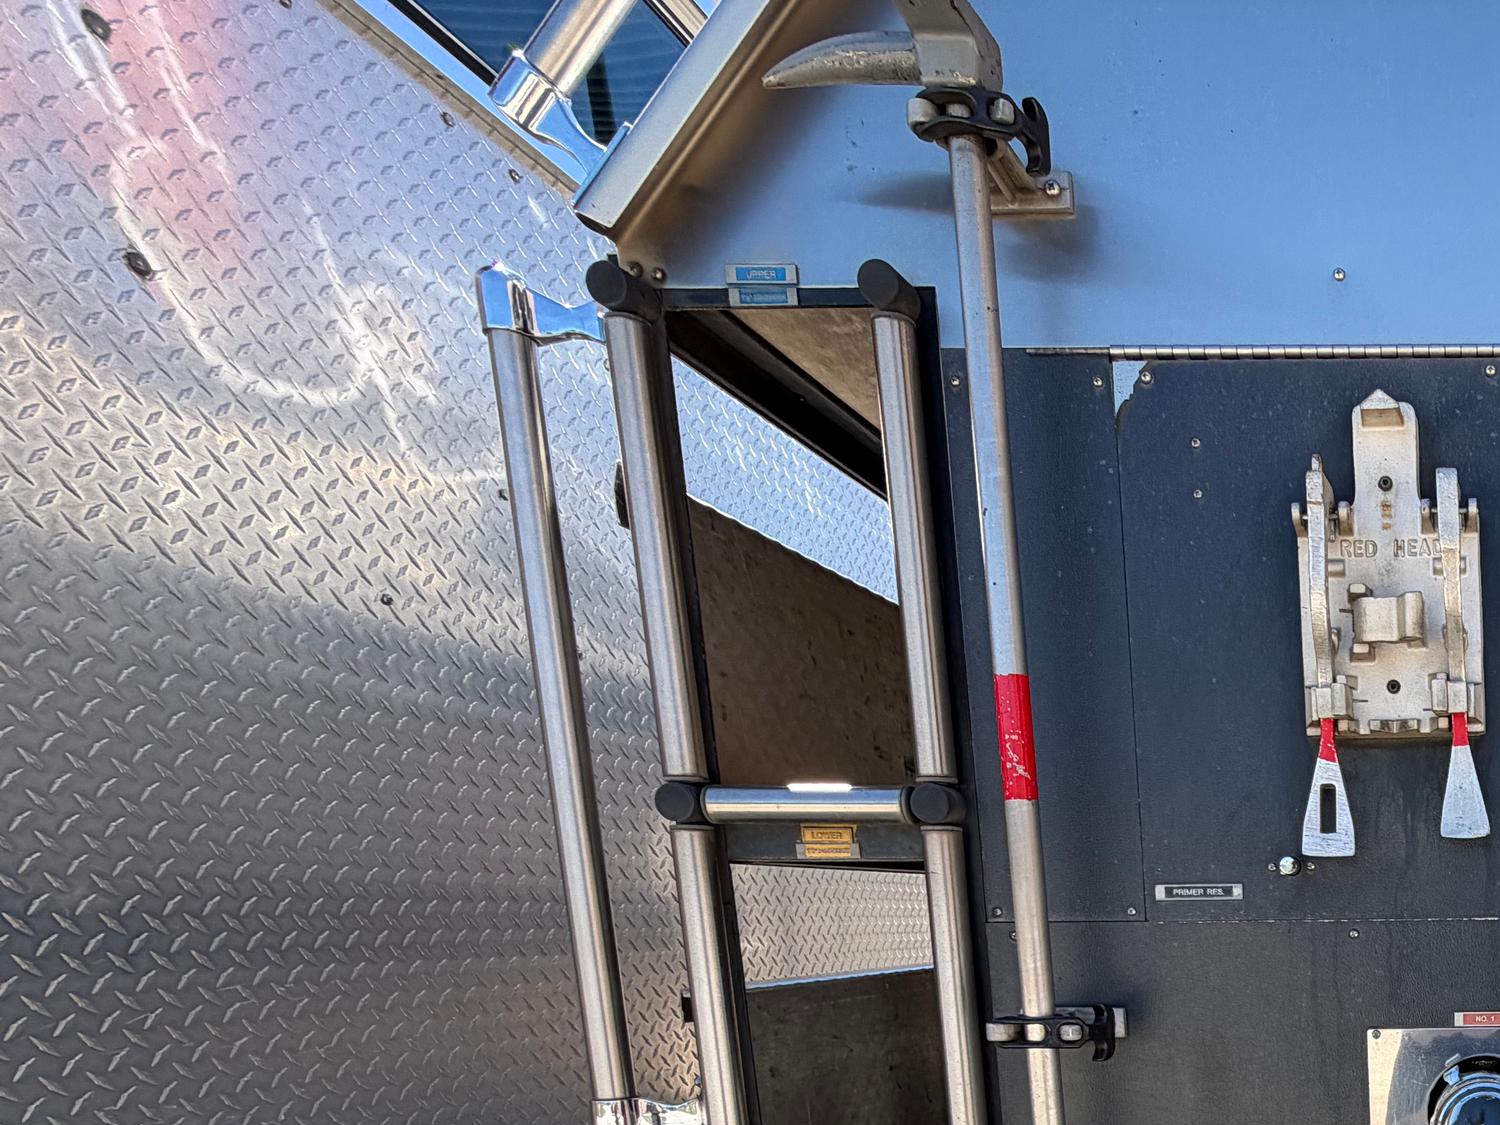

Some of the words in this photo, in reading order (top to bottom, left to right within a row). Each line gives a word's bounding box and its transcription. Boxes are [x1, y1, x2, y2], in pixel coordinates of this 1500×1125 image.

[745, 270, 777, 280] UPPER
[1340, 538, 1378, 558] RED
[1393, 538, 1442, 558] HEAD
[811, 831, 843, 840] LOWER
[1173, 888, 1204, 896] PRIMER
